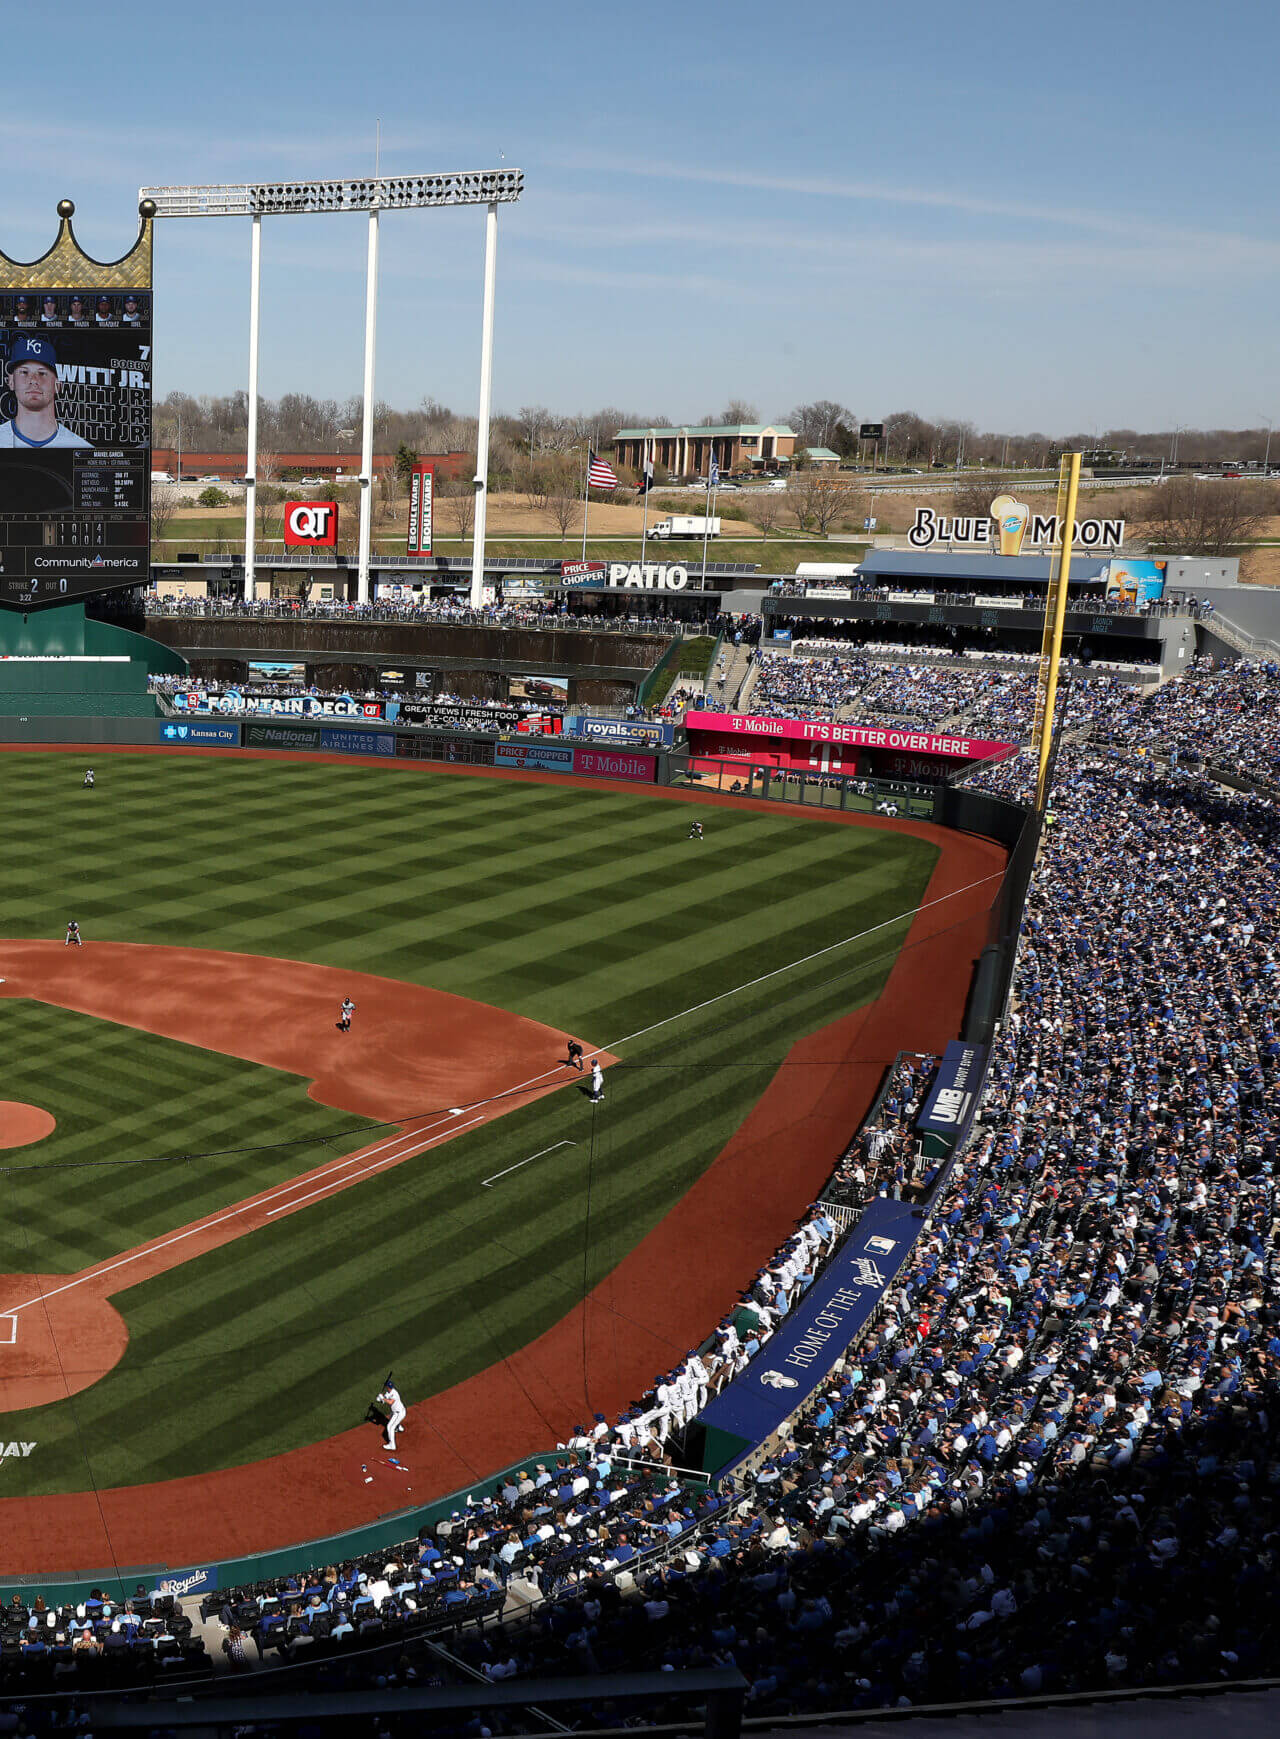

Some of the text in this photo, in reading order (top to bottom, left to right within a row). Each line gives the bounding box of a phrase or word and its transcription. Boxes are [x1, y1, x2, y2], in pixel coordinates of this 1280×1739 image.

[26, 339, 42, 354] KC
[139, 345, 150, 360] 7
[111, 358, 150, 370] BOBBY
[55, 364, 150, 388] WITT JR.
[55, 382, 150, 406] WITT JR.
[55, 400, 150, 425] WITT JR.
[120, 424, 150, 442] JR.
[409, 478, 420, 545] BOULEVARD
[422, 478, 432, 545] BOULEVARD
[72, 524, 76, 532] 0
[96, 524, 102, 532] 4
[289, 506, 330, 538] QT
[908, 508, 991, 548] BLUE
[72, 536, 76, 544] 0
[84, 536, 89, 544] 0
[96, 536, 102, 544] 4
[564, 562, 590, 574] PRICE
[31, 578, 38, 592] 2
[60, 578, 68, 592] 0
[562, 572, 605, 586] CHOPPER
[609, 564, 688, 590] PATIO
[208, 696, 379, 716] FOUNTAIN DECK QT
[404, 704, 519, 721] GREAT VIEWS FRESH FOOD
[190, 729, 234, 740] Kansas City
[586, 721, 660, 739] royals.com
[744, 720, 784, 734] Mobile
[265, 730, 318, 742] National
[332, 734, 374, 742] UNITED
[804, 724, 970, 756] IT'S BETTER OVER HERE
[322, 741, 374, 750] AIRLINES
[500, 746, 568, 762] PRICE CHOPPER
[726, 746, 752, 758] Mobile
[598, 756, 646, 776] Mobile
[929, 1088, 964, 1122] UMB
[784, 1258, 886, 1368] HOME OF THE Royals
[166, 1570, 208, 1595] Royals
